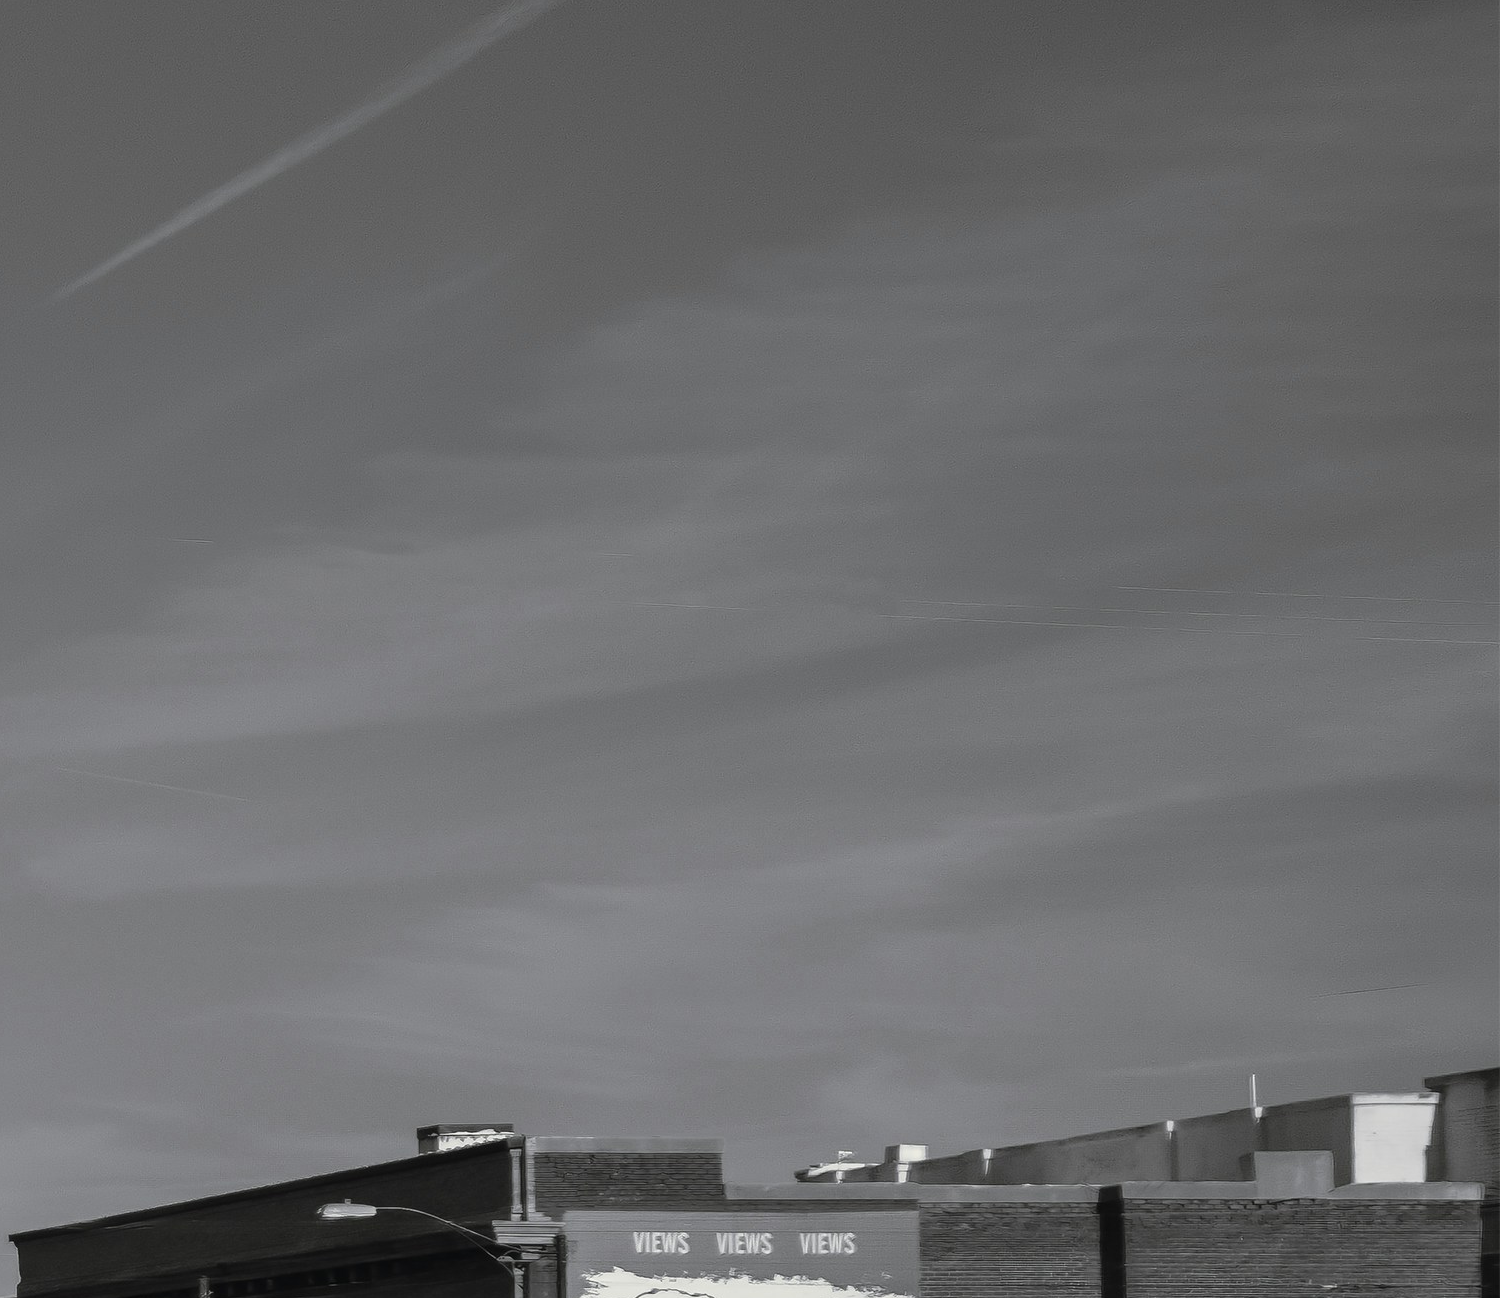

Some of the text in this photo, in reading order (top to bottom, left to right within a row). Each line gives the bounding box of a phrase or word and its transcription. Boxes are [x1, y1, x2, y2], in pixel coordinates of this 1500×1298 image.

[632, 1232, 857, 1255] VIEWS VIEWS VIEWS
